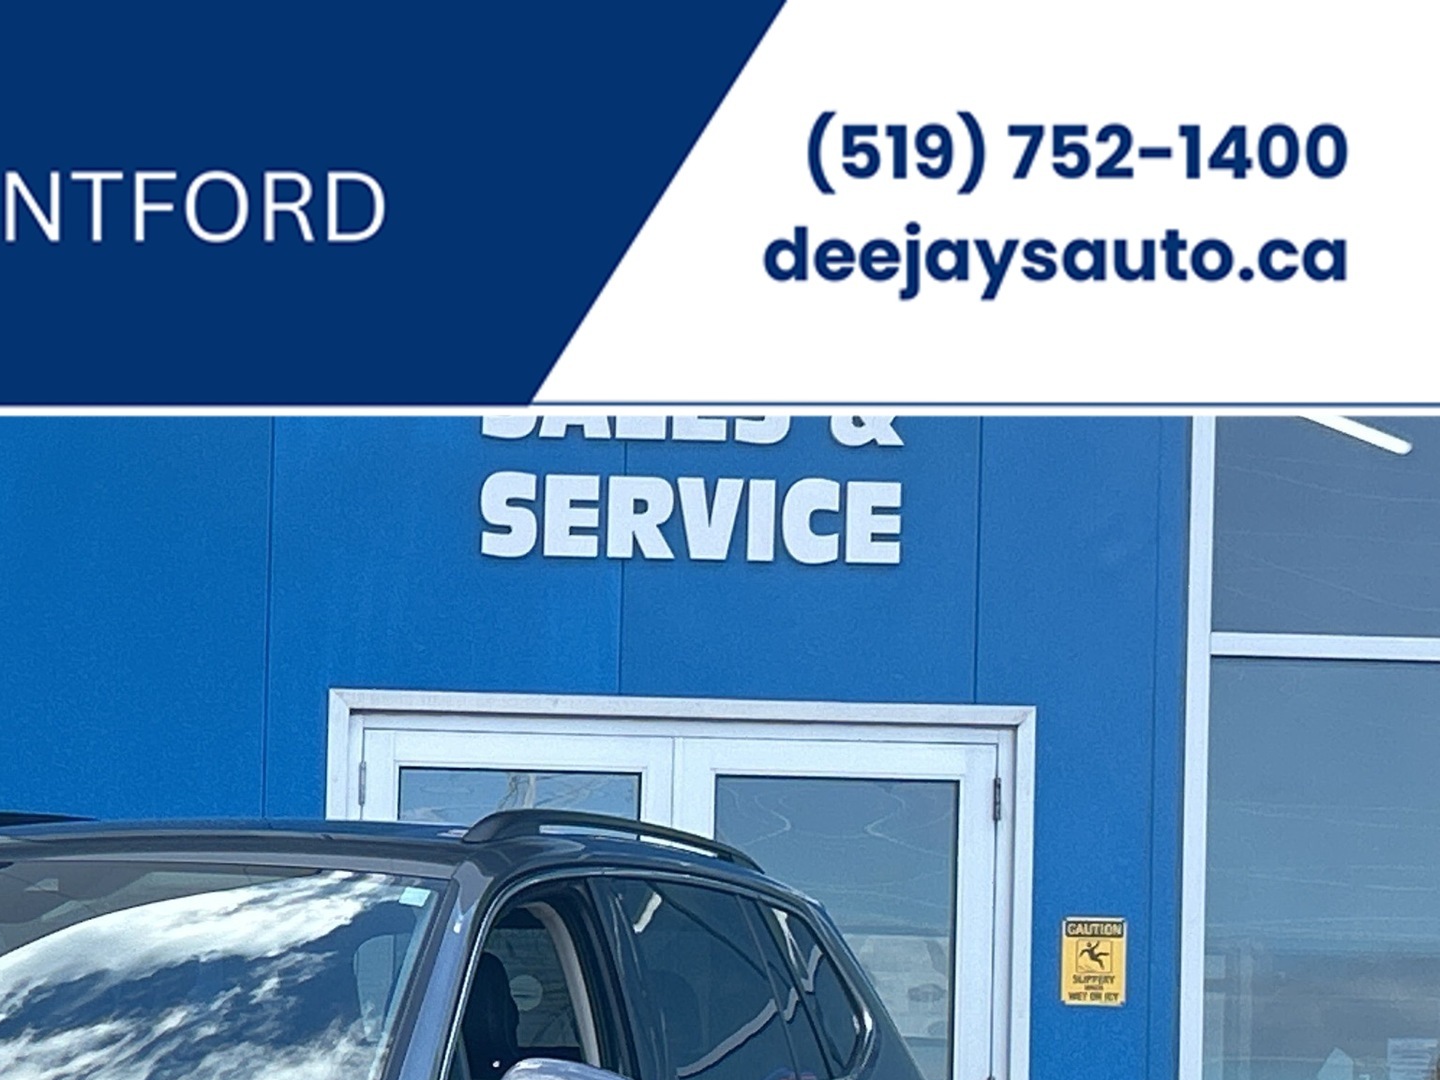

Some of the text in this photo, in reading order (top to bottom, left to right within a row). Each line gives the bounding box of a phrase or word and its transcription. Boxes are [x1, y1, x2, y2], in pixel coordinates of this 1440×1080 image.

[479, 470, 903, 566] SERVICE
[1068, 923, 1122, 936] CAUTION
[1073, 975, 1116, 985] SLIPPERY
